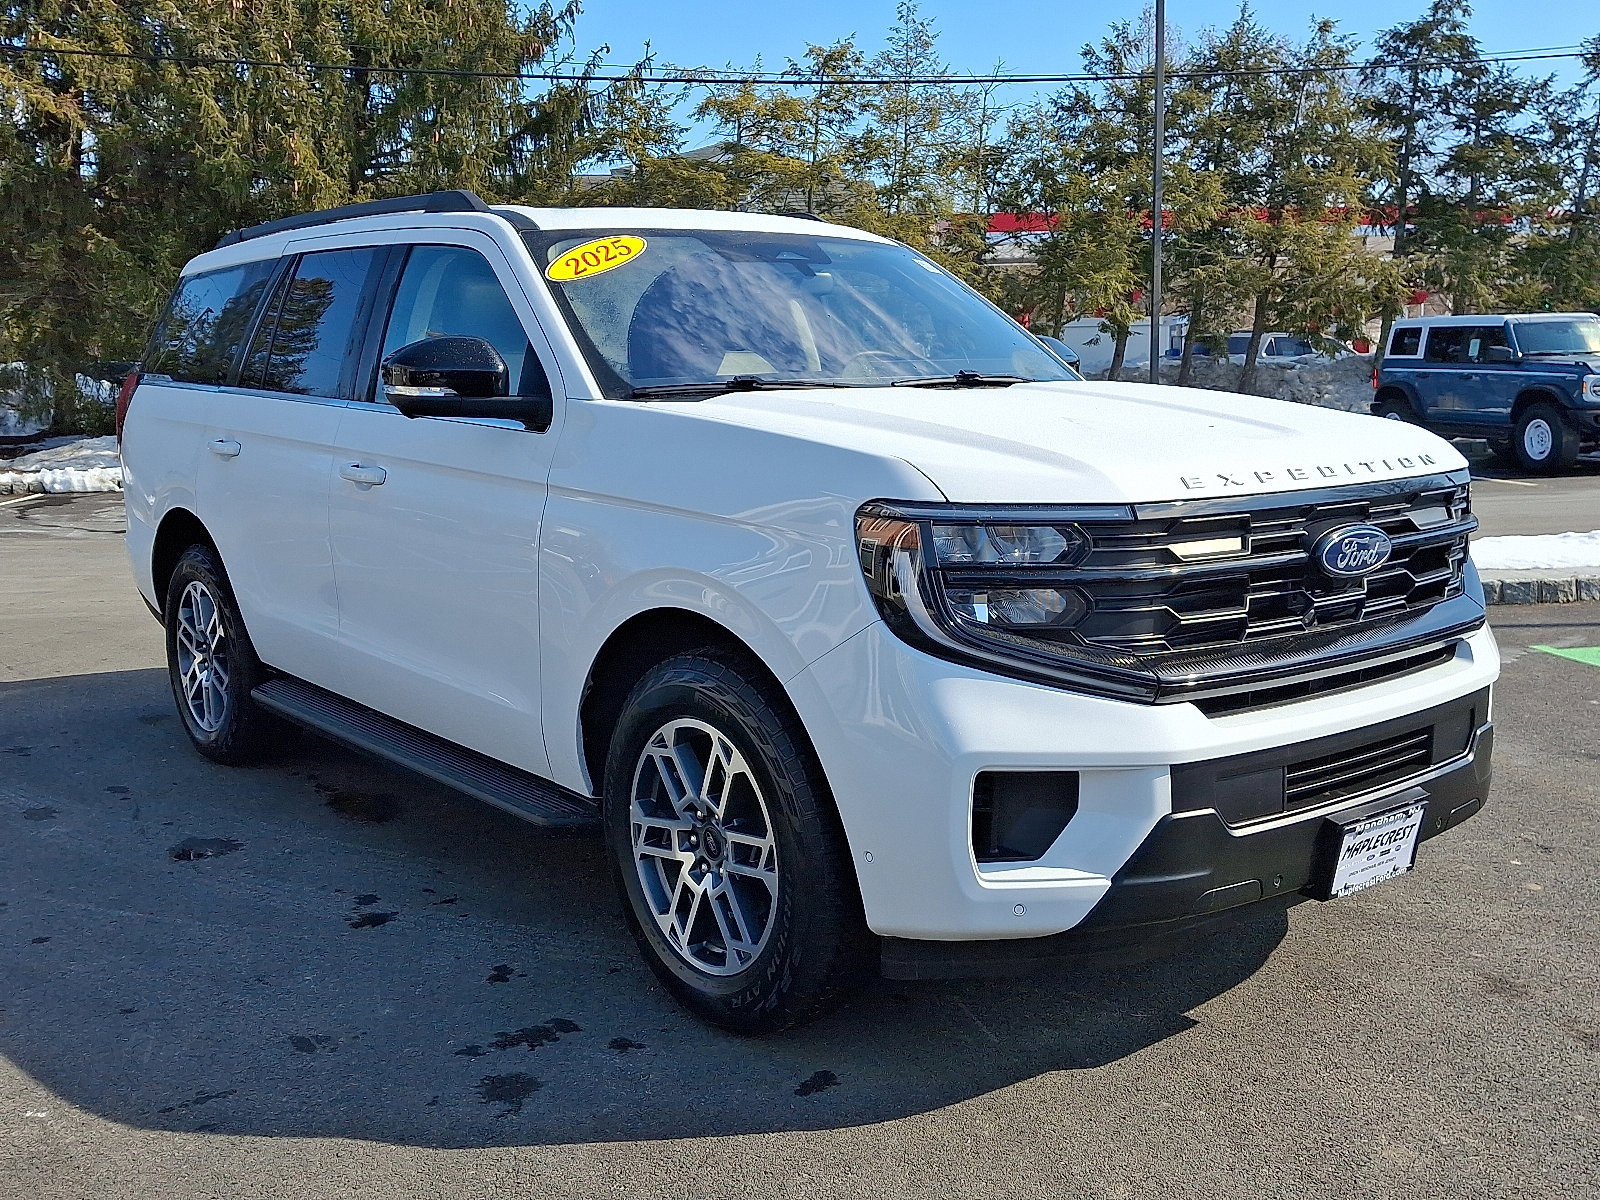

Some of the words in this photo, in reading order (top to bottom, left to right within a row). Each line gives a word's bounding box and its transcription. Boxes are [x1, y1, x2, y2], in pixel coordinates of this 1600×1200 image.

[565, 239, 632, 275] 2025
[1180, 454, 1437, 489] EXPEDITION
[1337, 537, 1381, 569] Ford
[1341, 822, 1417, 861] MAPLECREST
